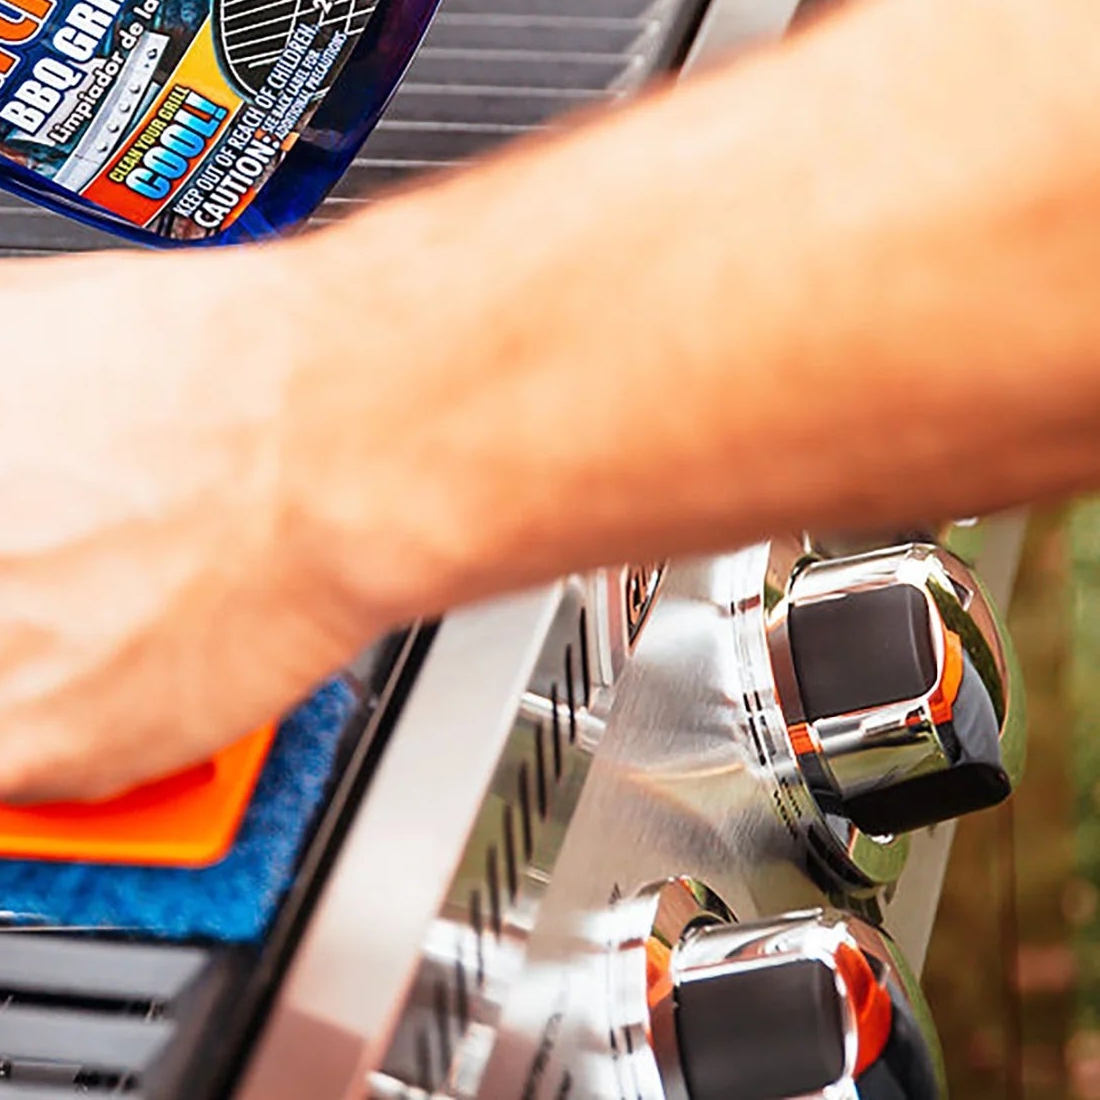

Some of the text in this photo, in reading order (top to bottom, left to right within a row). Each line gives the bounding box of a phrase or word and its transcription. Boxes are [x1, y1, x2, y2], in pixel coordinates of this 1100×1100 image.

[48, 49, 124, 146] Limpiador
[120, 22, 144, 51] de
[109, 85, 190, 183] CLEAN YOUR GRILL
[173, 23, 320, 217] KEEP OUT OF REACH OF CHILDREN.
[125, 91, 228, 200] COOL!
[194, 135, 281, 228] CAUTION:
